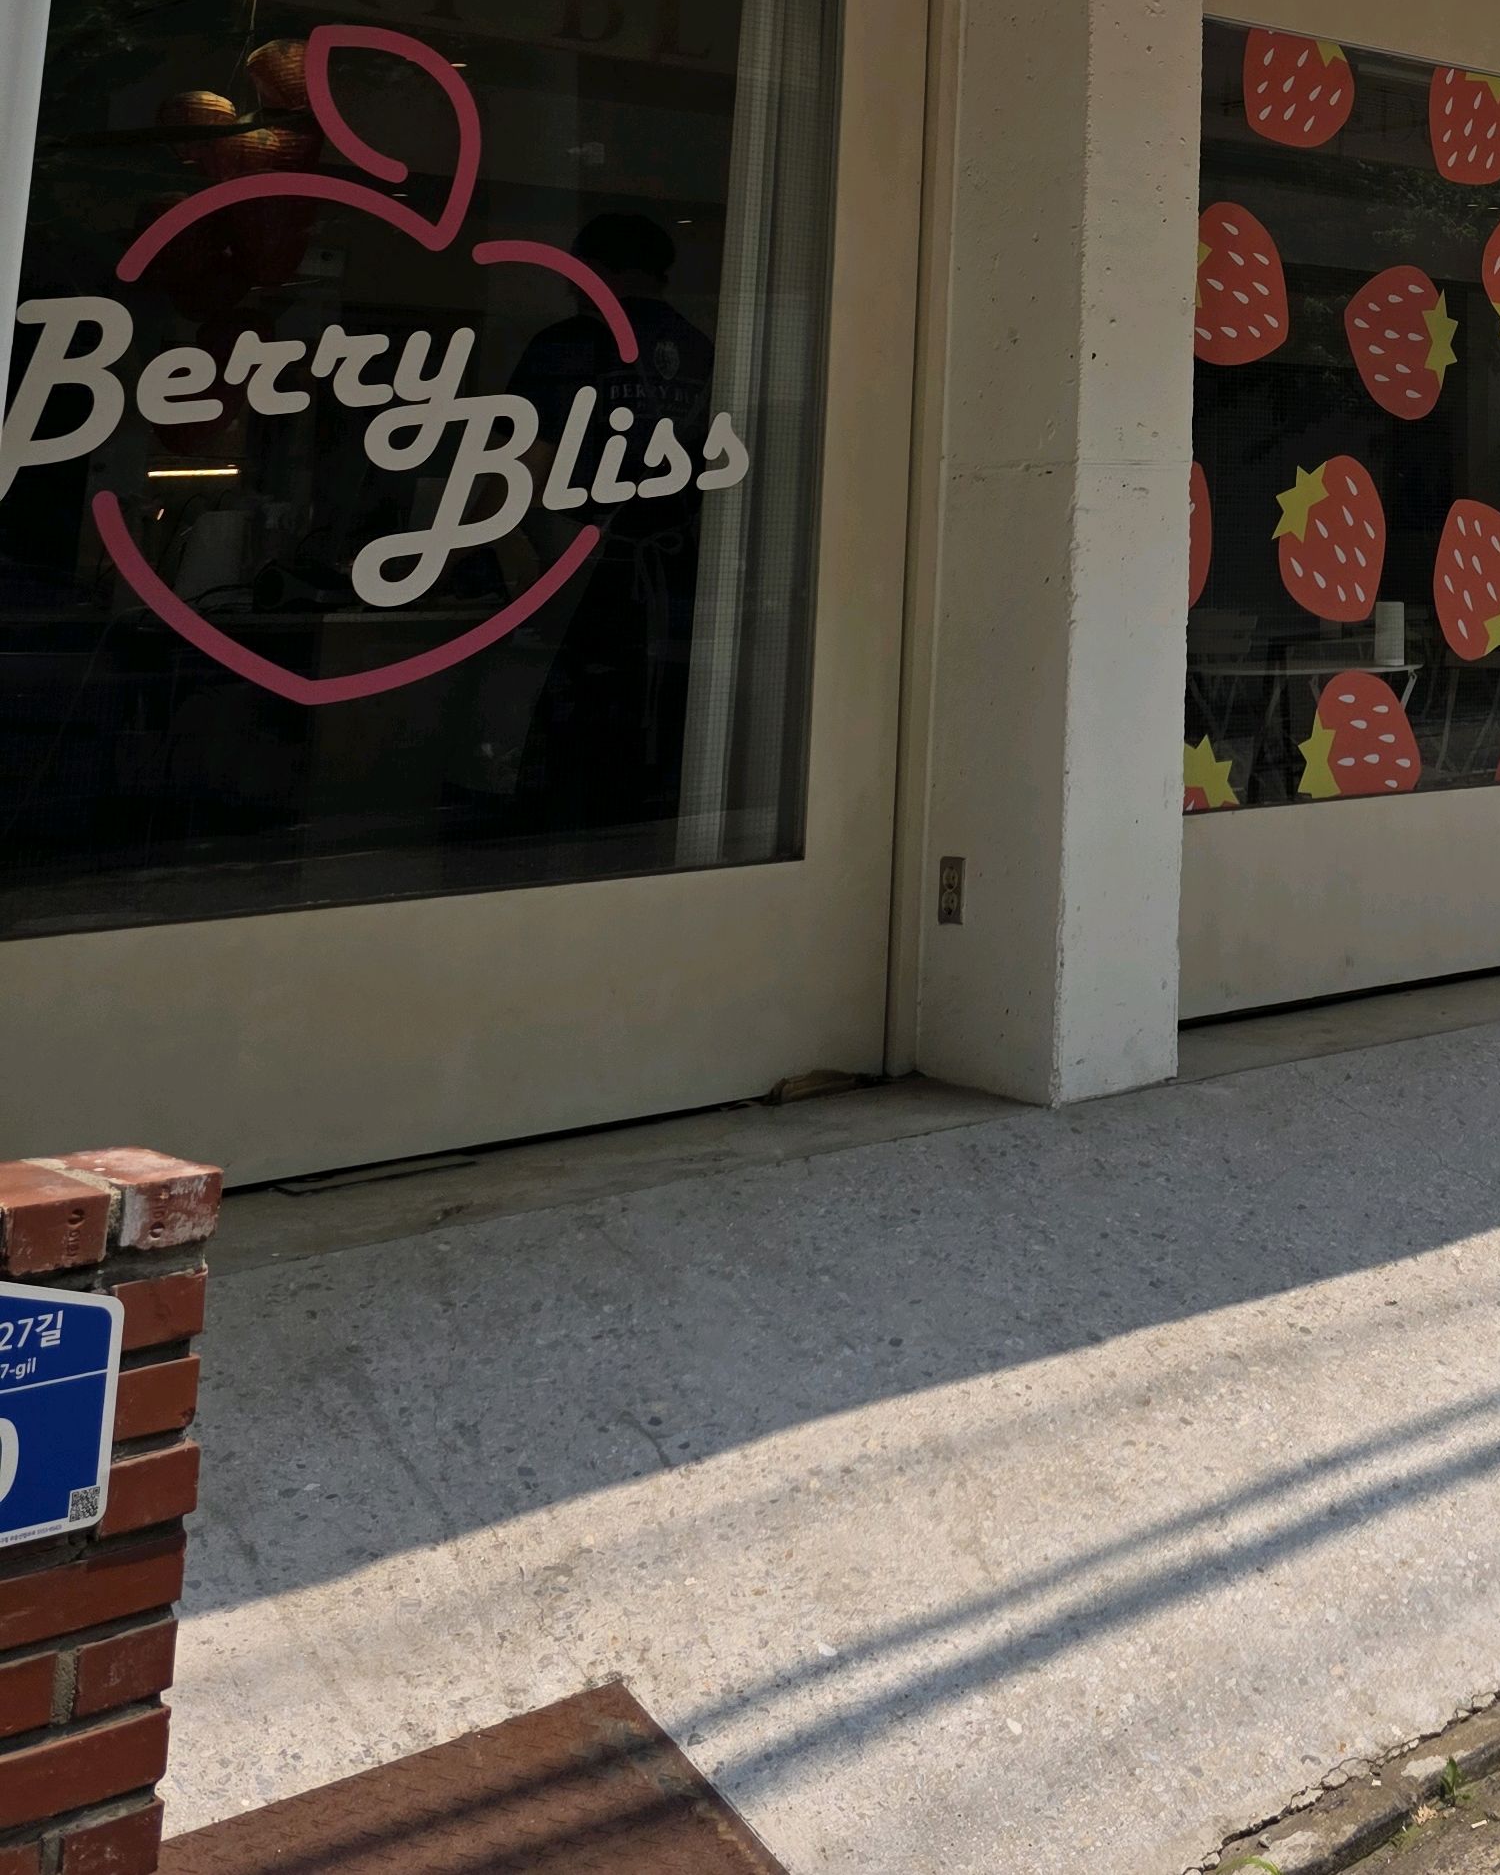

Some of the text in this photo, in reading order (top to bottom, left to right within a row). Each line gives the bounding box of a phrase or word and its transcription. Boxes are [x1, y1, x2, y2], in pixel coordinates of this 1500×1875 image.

[0, 296, 476, 502] Berry
[352, 386, 750, 608] Bliss
[0, 1310, 64, 1351] 27길
